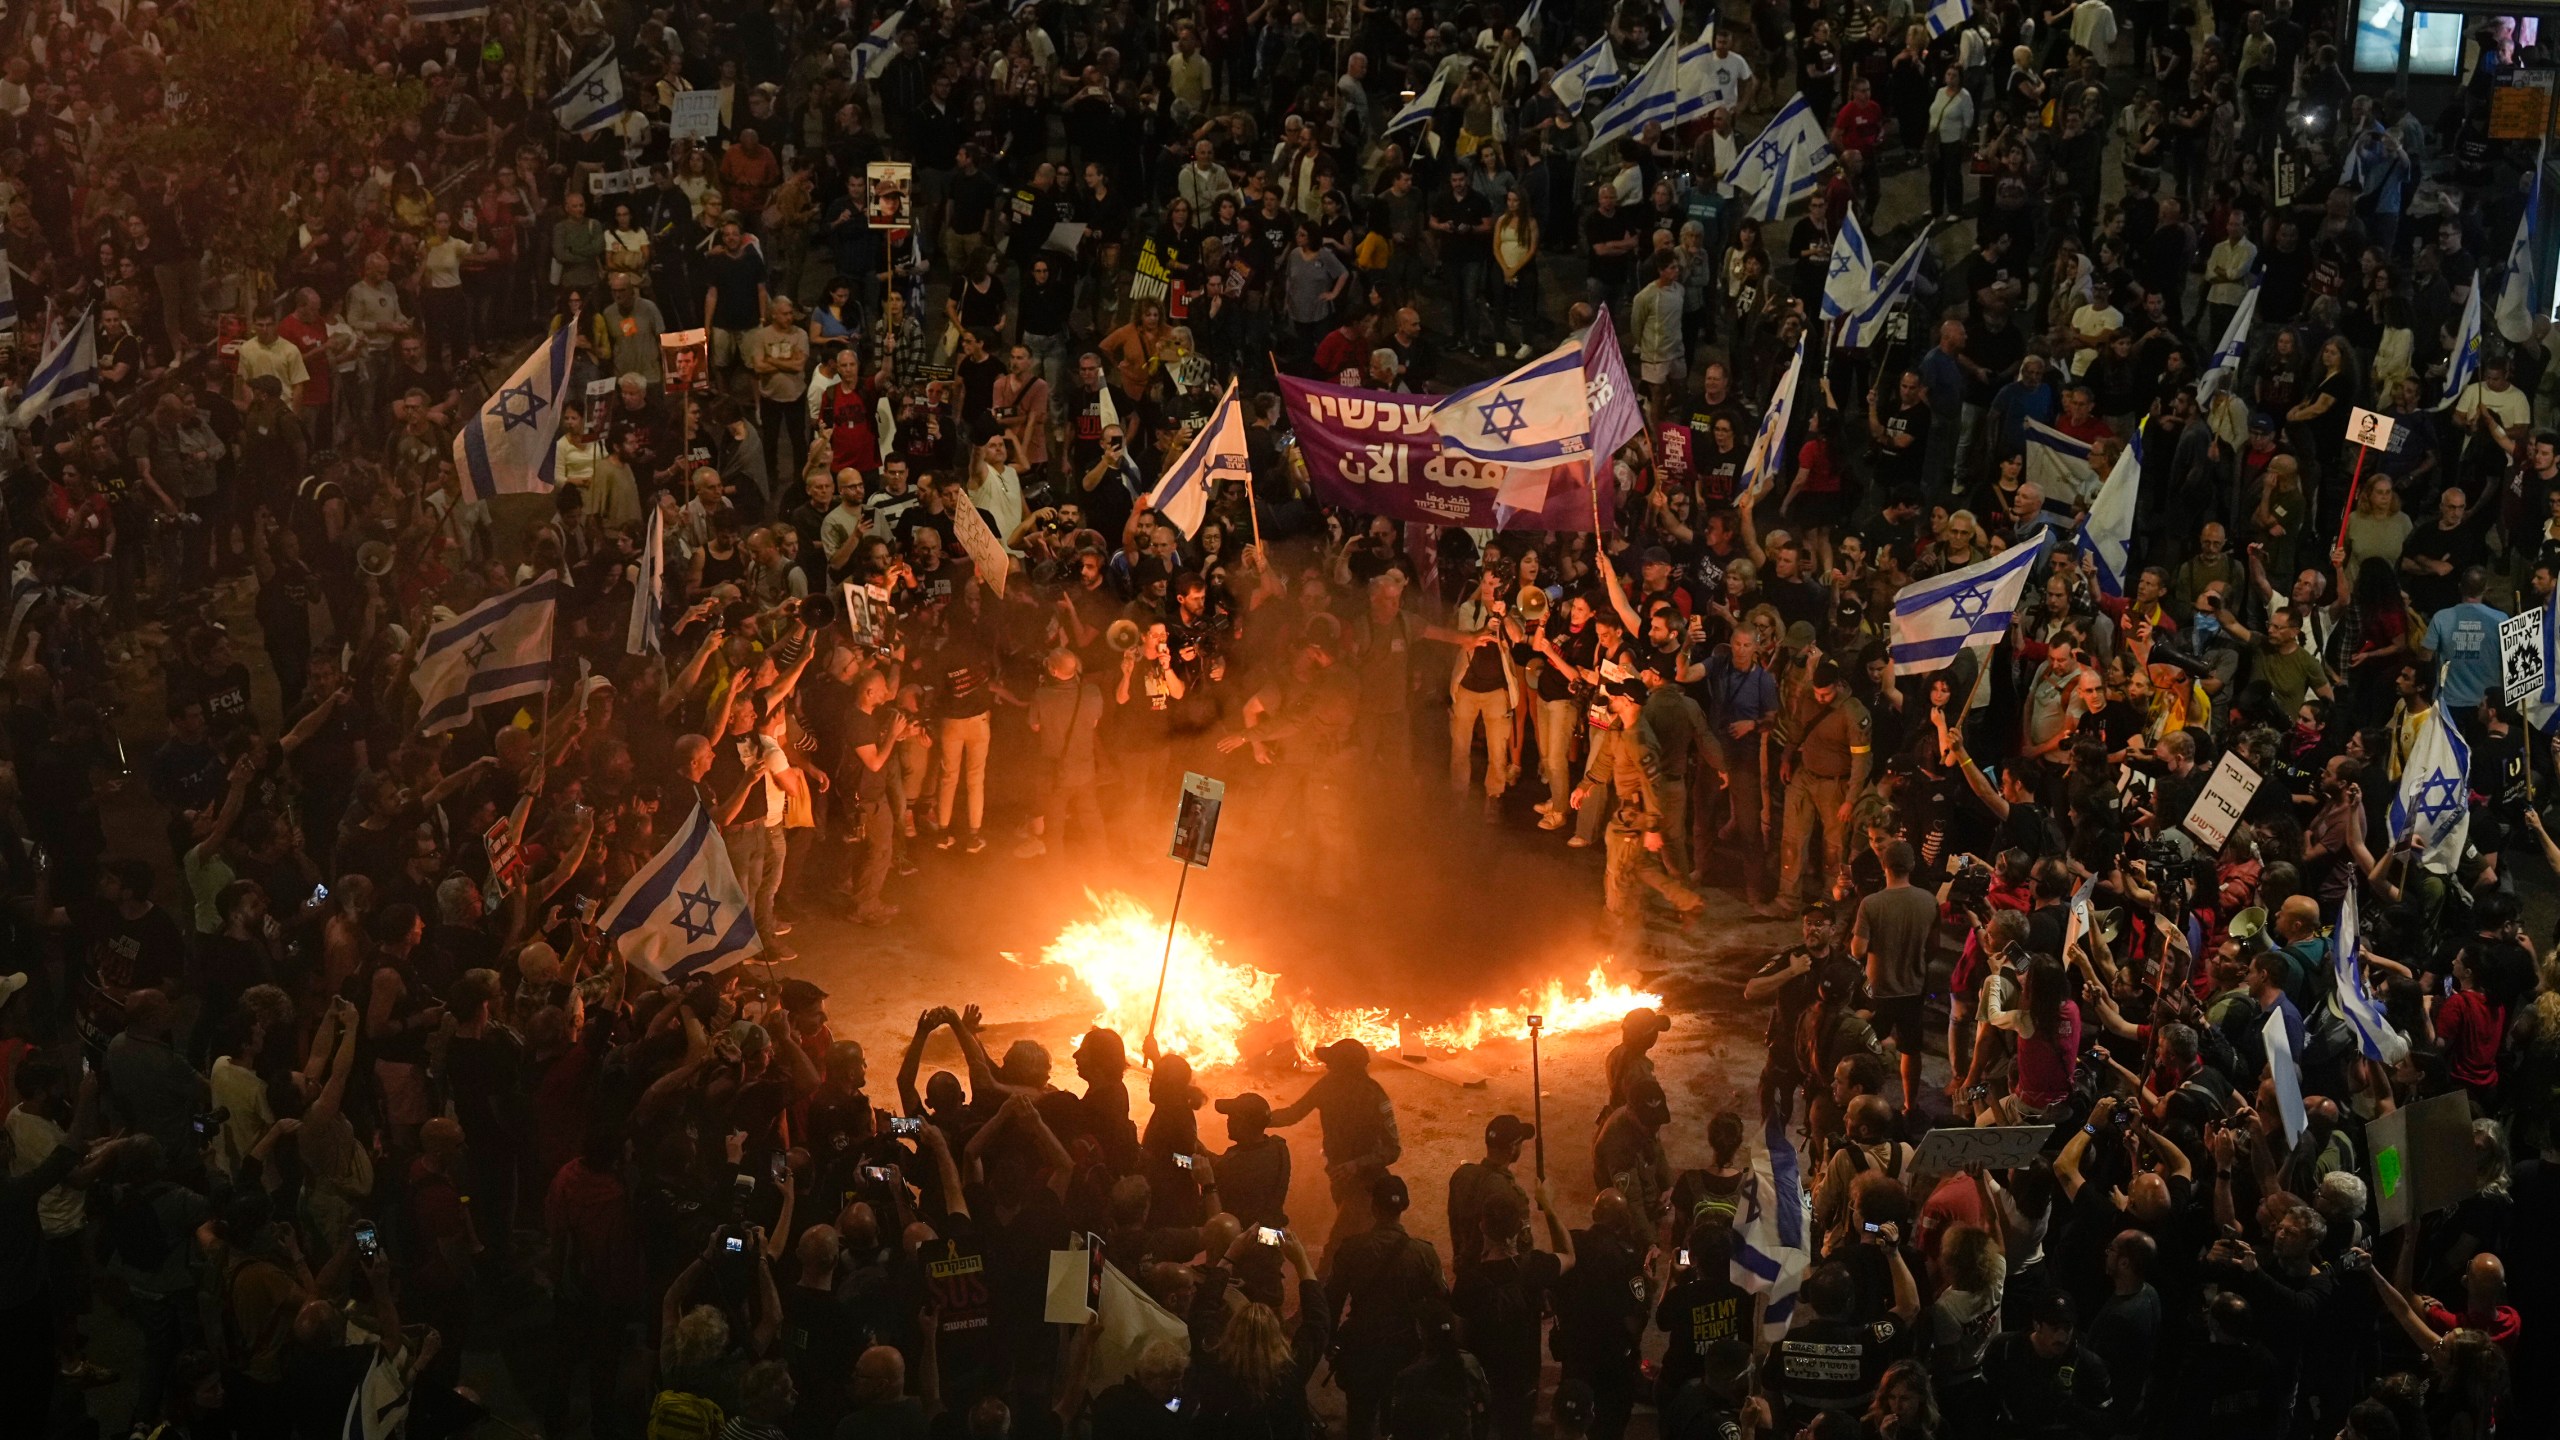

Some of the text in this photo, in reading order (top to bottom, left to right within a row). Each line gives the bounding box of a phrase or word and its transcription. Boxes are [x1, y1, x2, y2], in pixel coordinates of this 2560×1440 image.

[1137, 250, 1171, 283] HOME
[1305, 393, 1434, 435] עכשיו
[1338, 442, 1408, 484] الآن
[1414, 499, 1471, 513] עומדים ביחד
[2501, 609, 2541, 637] מי שהרס
[2524, 623, 2540, 640] לא
[210, 689, 244, 713] FCK
[2225, 763, 2255, 794] בן גביר
[2204, 789, 2240, 819] עבריין
[1692, 1297, 1737, 1325] GET MY
[1693, 1316, 1739, 1340] PEOPLE
[1787, 1343, 1857, 1355] ISRAEL POLICE
[1819, 1361, 1849, 1370] משטרת
